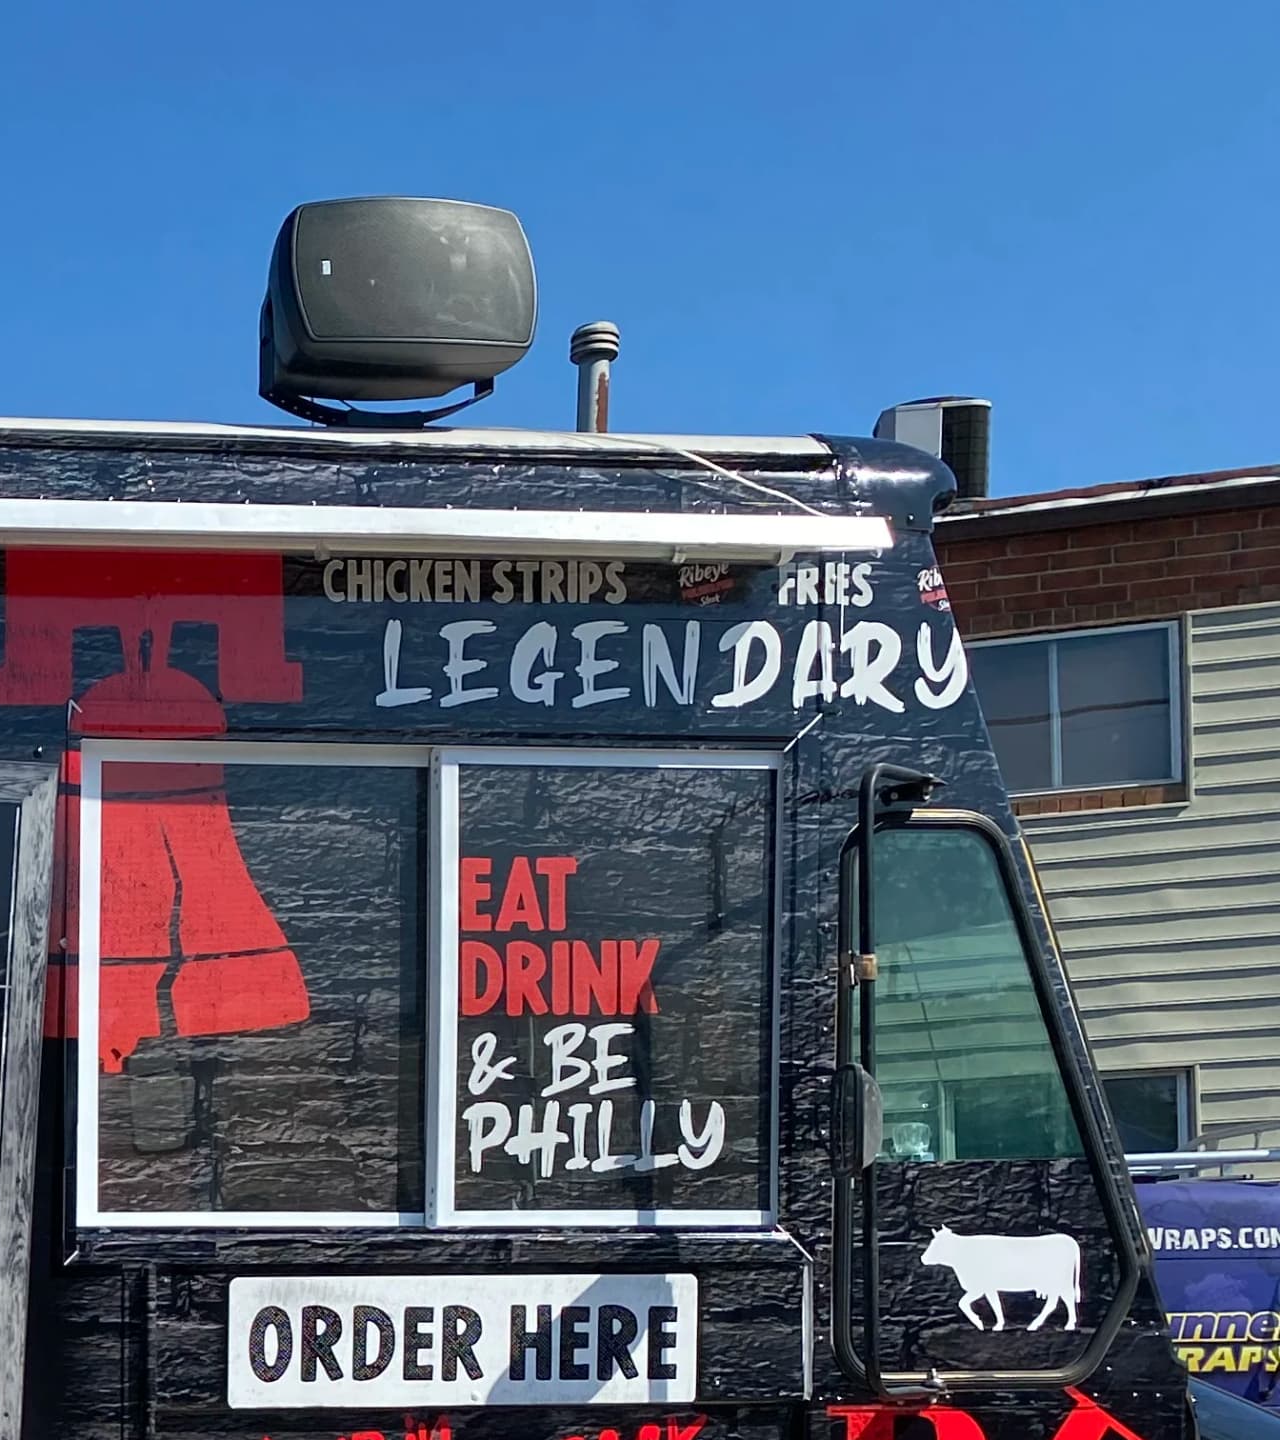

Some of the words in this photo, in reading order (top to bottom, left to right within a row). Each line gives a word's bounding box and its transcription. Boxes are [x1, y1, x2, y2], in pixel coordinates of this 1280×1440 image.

[322, 558, 479, 604] CHICKEN
[491, 560, 627, 604] STRIPS
[778, 561, 874, 607] FRIES
[376, 617, 968, 714] LEGENDARY
[461, 856, 577, 932] EAT
[461, 938, 660, 1015] DRINK
[468, 1031, 516, 1096] &
[541, 1024, 636, 1099] BE
[462, 1100, 726, 1178] PHILLY
[248, 1303, 483, 1383] ORDER
[508, 1302, 678, 1383] HERE
